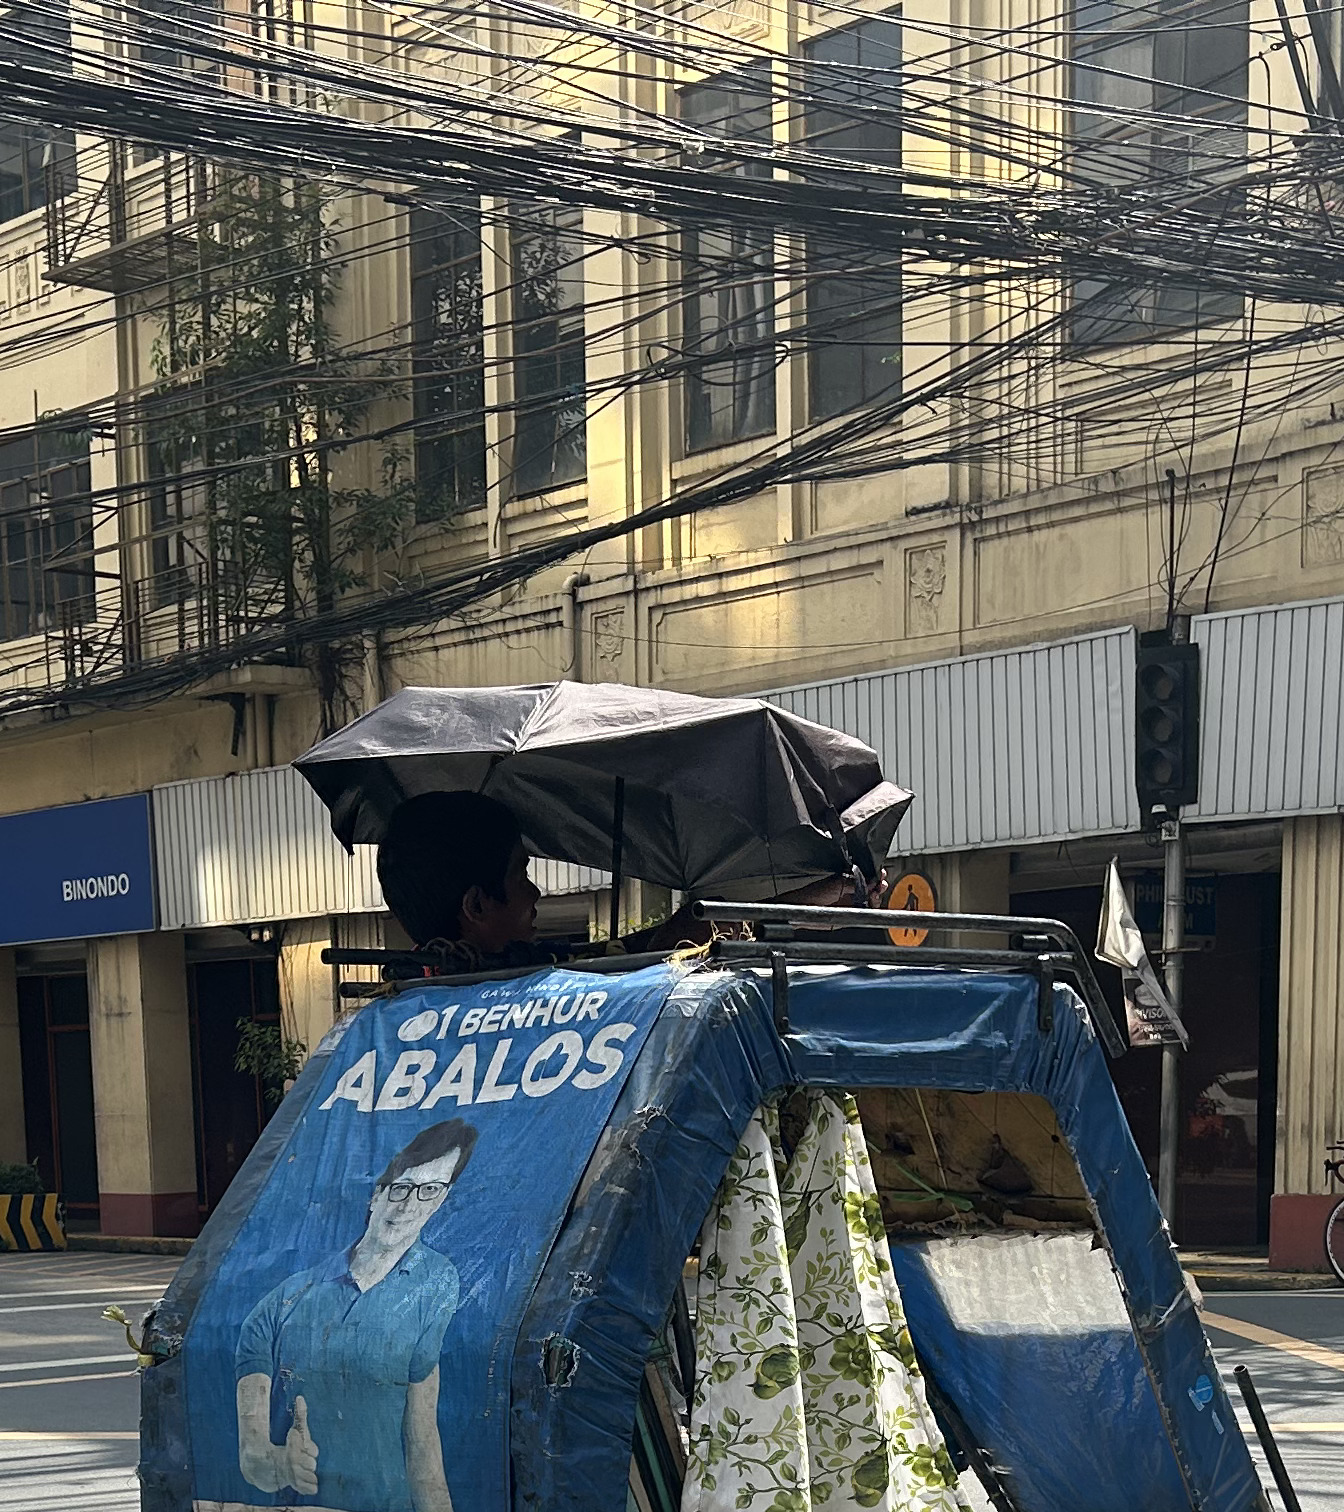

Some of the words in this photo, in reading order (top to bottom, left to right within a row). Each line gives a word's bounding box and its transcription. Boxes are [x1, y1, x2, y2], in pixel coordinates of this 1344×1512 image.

[62, 873, 129, 901] BINONDO
[1137, 883, 1214, 905] PHIUST
[458, 991, 608, 1037] BENHUR
[319, 1023, 637, 1112] ABALOS
